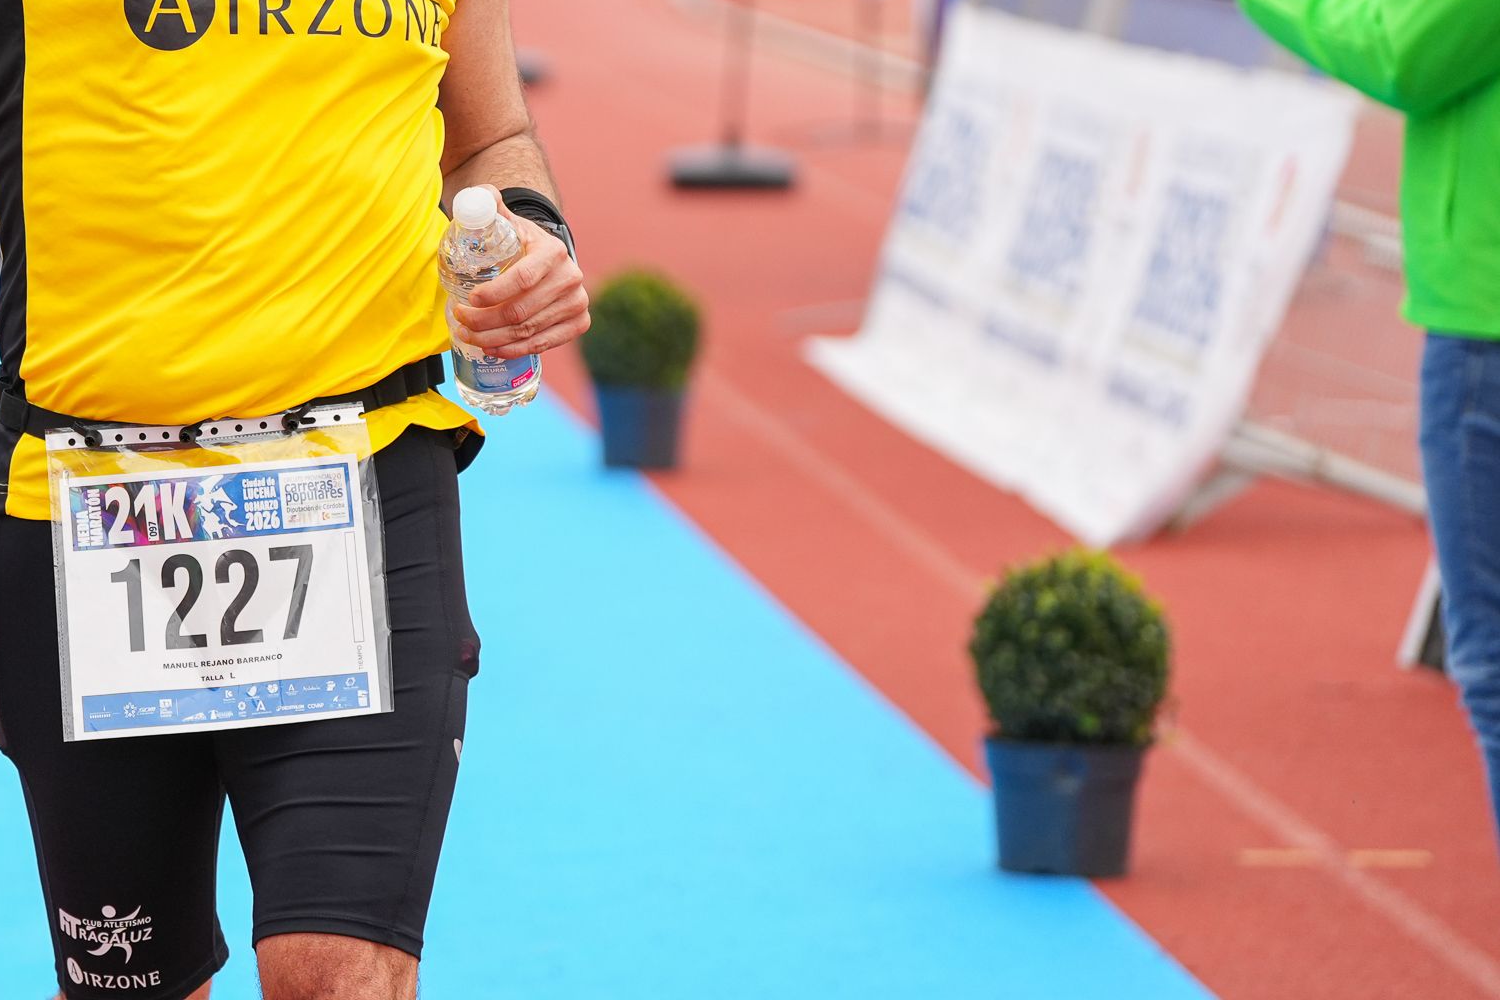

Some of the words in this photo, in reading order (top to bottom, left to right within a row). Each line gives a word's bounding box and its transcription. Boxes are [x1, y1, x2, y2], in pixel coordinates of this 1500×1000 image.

[242, 478, 266, 488] Ciudad
[266, 476, 276, 486] de
[284, 479, 333, 494] carreras
[243, 486, 277, 500] LUCENA
[285, 486, 344, 506] populares
[104, 481, 194, 545] 21K
[254, 500, 279, 512] MARZO
[85, 488, 104, 546] MARATÓN
[245, 511, 281, 531] 2026
[76, 510, 91, 547] MEDIA
[110, 544, 314, 652] 1227
[162, 661, 199, 669] MANUEL
[200, 659, 234, 668] REJANO
[236, 653, 283, 664] BARRANCO
[201, 674, 224, 682] TALLA
[82, 918, 102, 928] CLUB
[103, 916, 152, 928] ATLETISMO
[66, 957, 161, 990] AIRZONE
